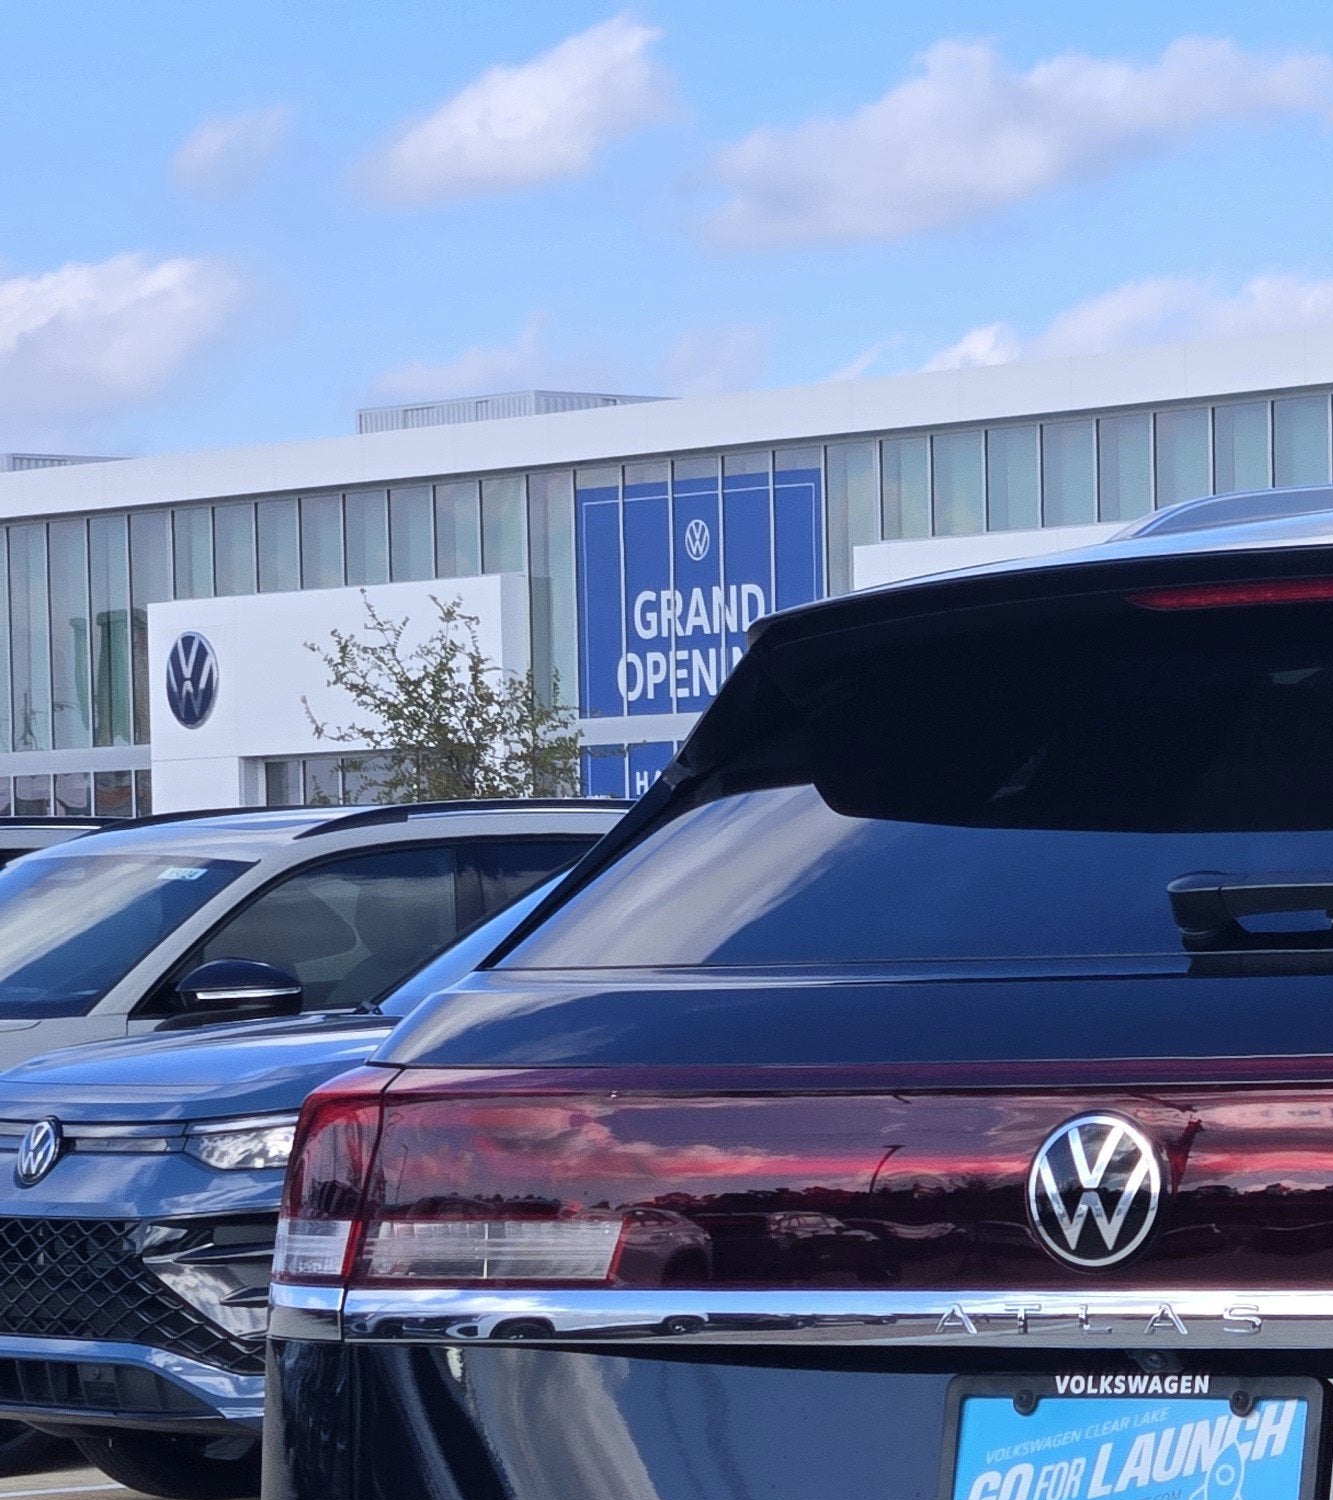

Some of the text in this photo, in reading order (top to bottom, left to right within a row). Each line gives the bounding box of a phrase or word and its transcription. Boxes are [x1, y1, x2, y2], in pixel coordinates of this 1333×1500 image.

[634, 584, 765, 640] GRAND
[935, 1303, 1263, 1335] ATLAS
[1054, 1375, 1210, 1395] VOLKSWAGEN
[985, 1406, 1171, 1465] VOLKSWAGEN CLEAR LAKE
[1087, 1399, 1298, 1500] LAUNCH
